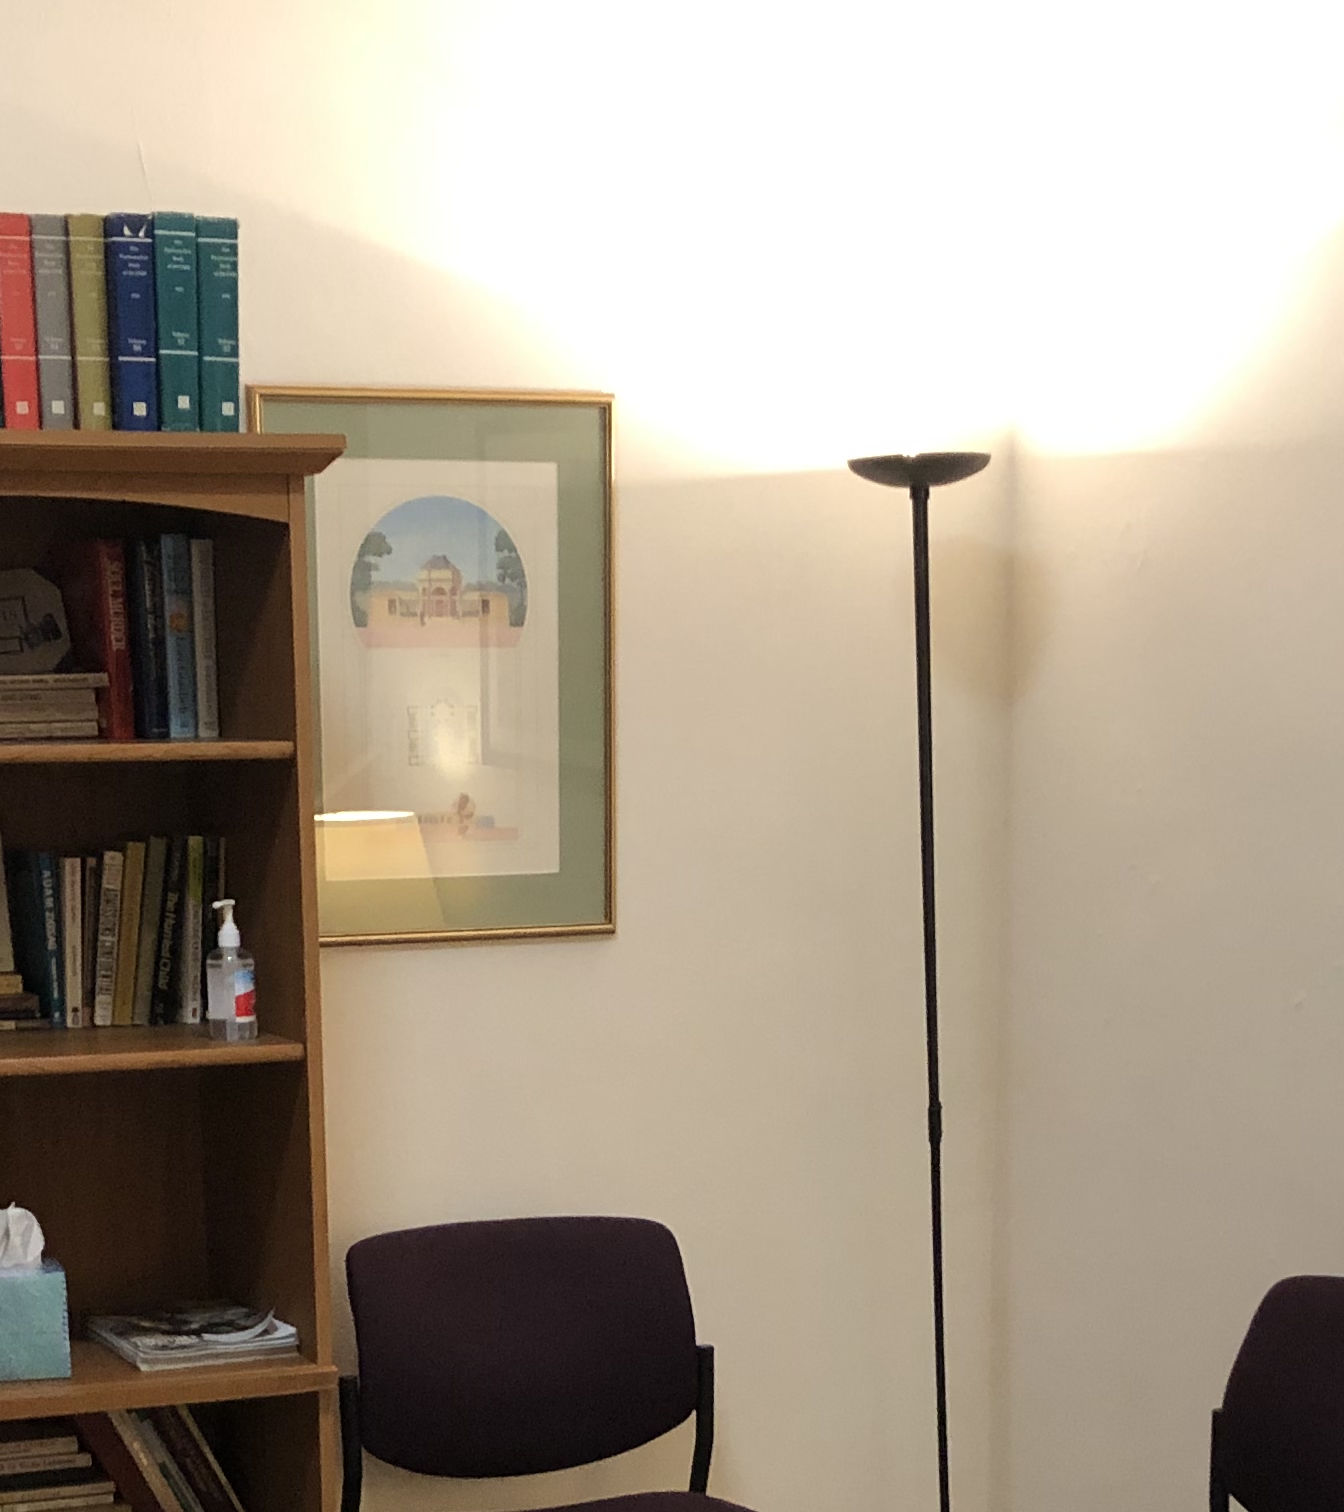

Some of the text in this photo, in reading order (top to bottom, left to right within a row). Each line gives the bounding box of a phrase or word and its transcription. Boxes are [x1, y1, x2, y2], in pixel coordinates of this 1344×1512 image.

[110, 596, 126, 651] MURDER
[43, 870, 54, 908] ADAM
[157, 959, 172, 991] Child
